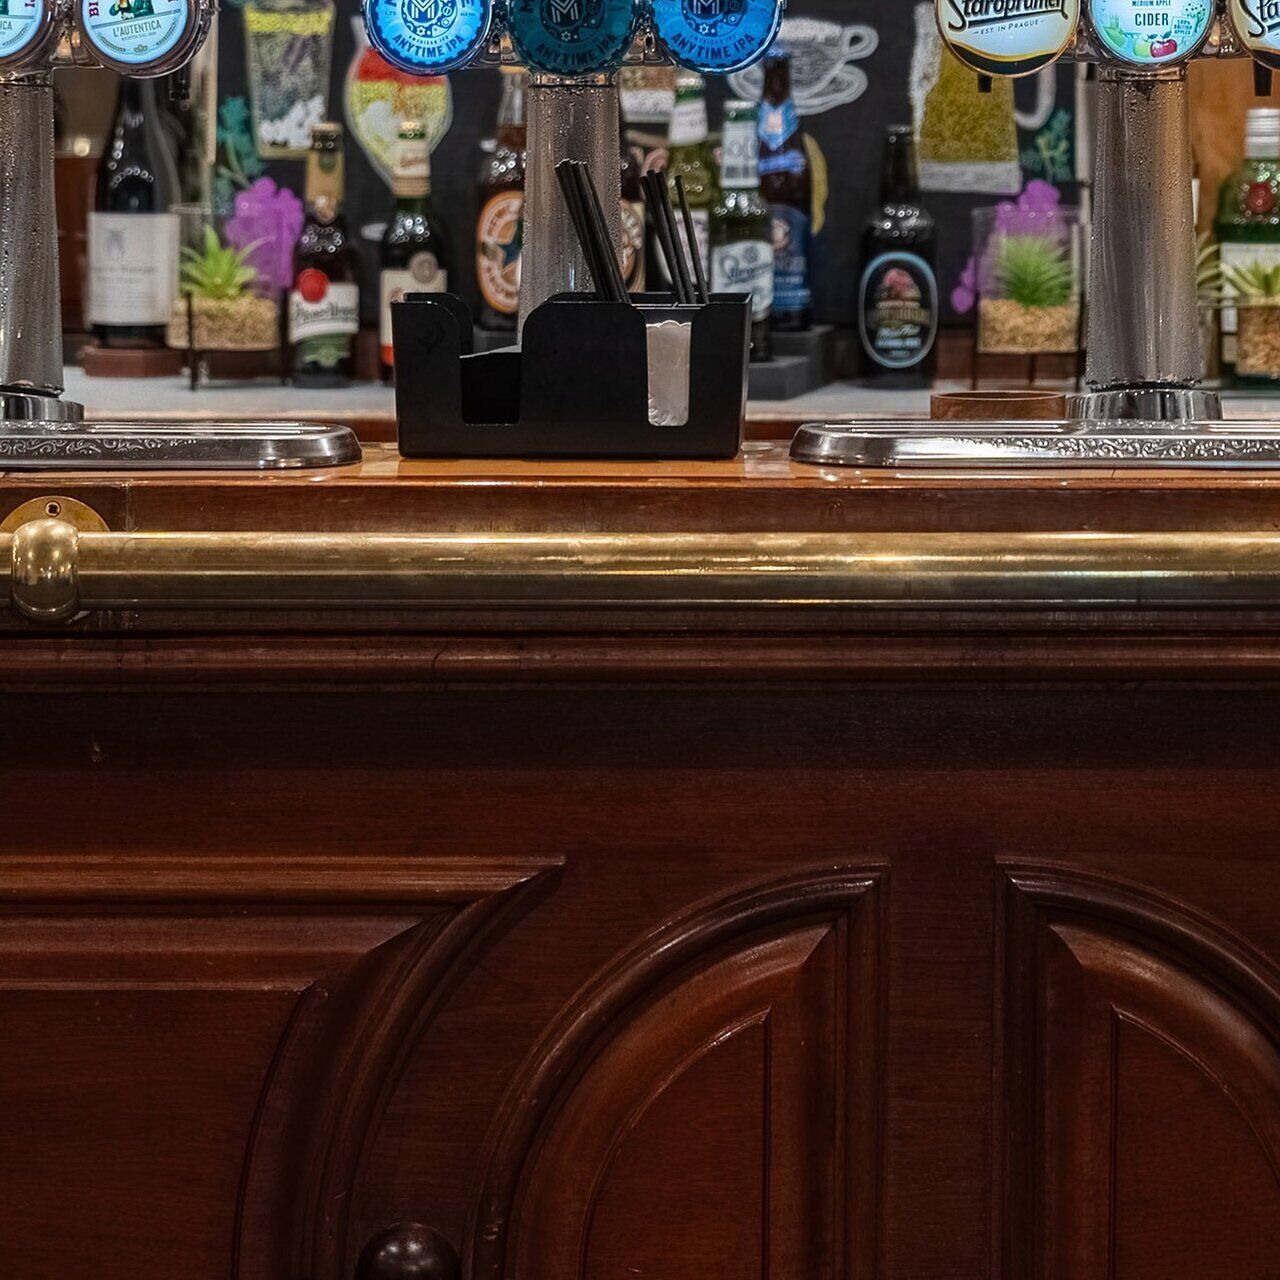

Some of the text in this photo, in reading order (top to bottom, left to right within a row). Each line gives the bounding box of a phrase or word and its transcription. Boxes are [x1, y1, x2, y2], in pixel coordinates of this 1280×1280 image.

[112, 18, 162, 38] L'AUTENTICA
[1008, 18, 1039, 31] PRAGUE
[1134, 12, 1169, 27] CIDER
[391, 33, 465, 58] ANYTIME IPA
[534, 33, 619, 66] ANYTIME IPA
[671, 32, 756, 60] ANYTIME IPA
